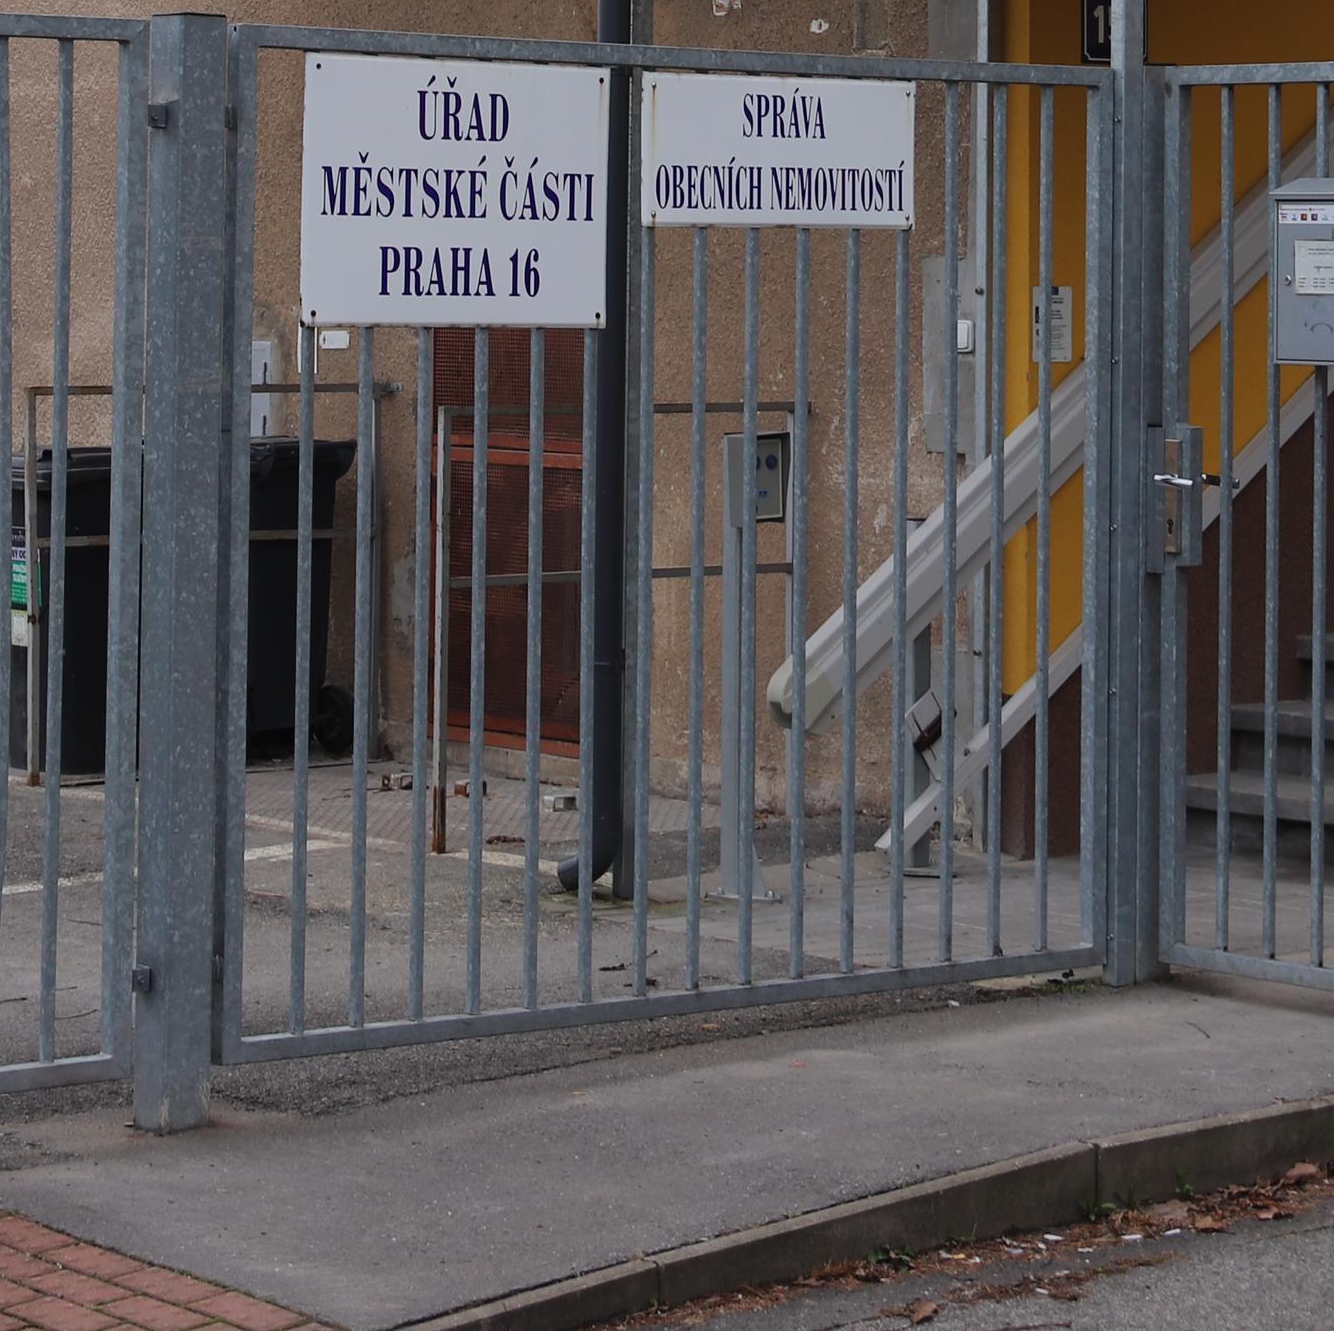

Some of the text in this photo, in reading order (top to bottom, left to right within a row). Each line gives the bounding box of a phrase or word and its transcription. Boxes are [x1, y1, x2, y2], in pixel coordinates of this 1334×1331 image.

[417, 74, 510, 142] ÚŘAD
[742, 87, 826, 140] SPRÁVA
[320, 151, 595, 222] MĚSTSKÉ ČÁSTI
[655, 156, 905, 213] OBECNÍCH NEMOVITOSTÍ
[378, 246, 541, 298] PRAHA 16
